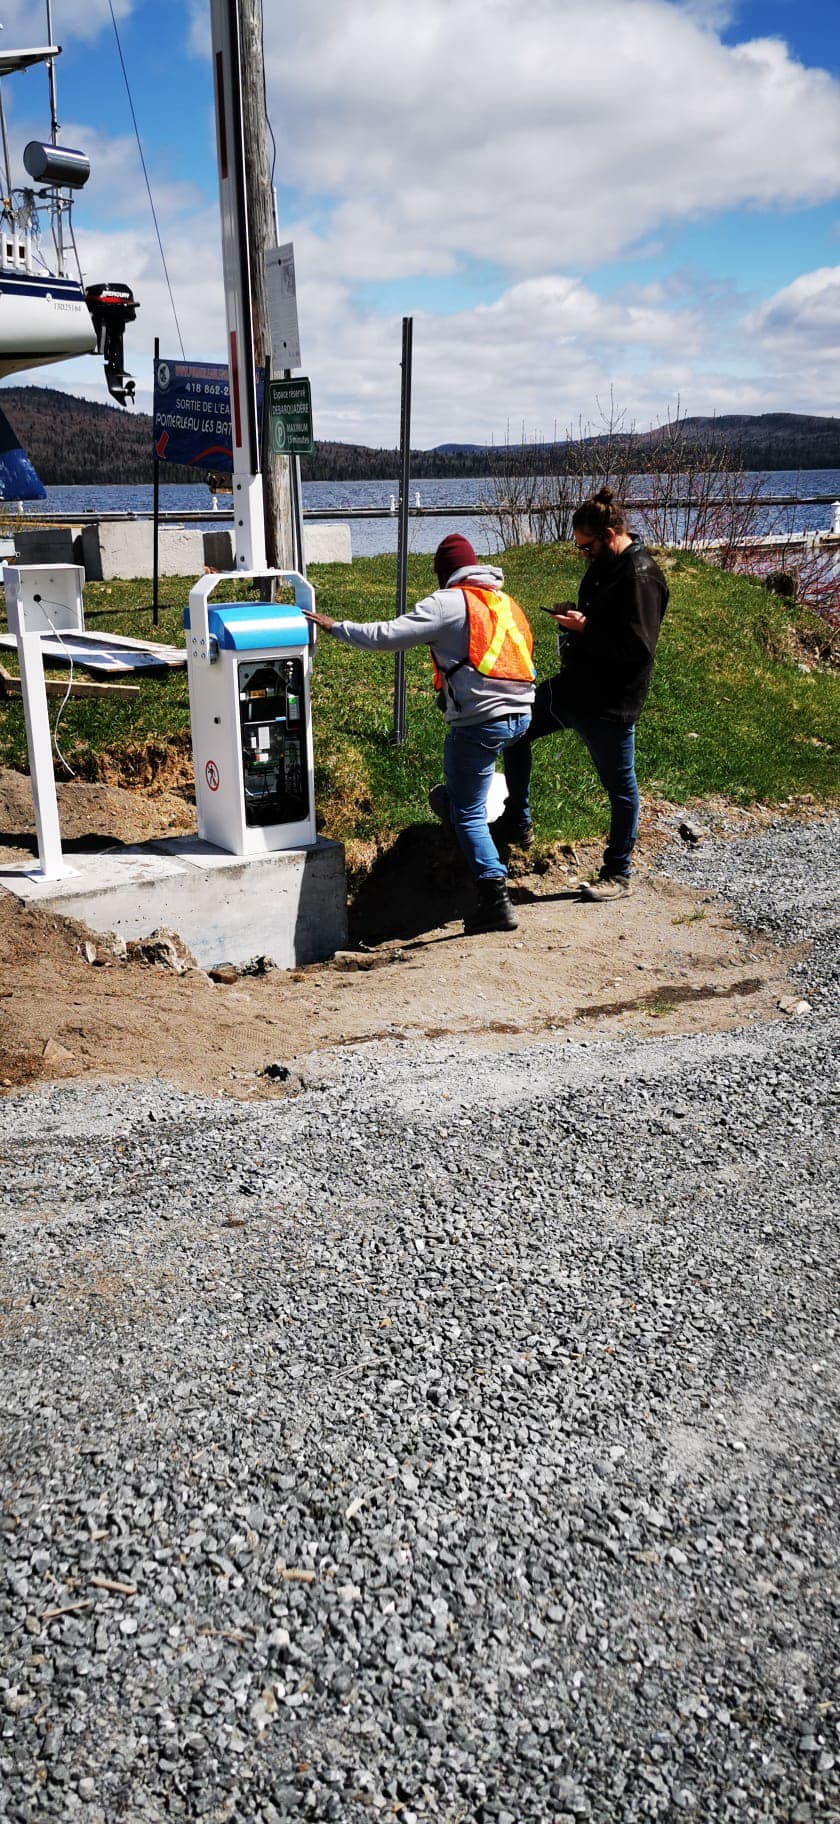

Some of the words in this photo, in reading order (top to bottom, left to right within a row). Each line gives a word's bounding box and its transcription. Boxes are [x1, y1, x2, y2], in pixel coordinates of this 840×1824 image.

[185, 382, 201, 393] 418
[204, 383, 230, 396] 862-2
[273, 389, 288, 400] Espace
[175, 398, 201, 411] SORTIE
[202, 401, 212, 413] DE
[214, 403, 231, 415] L'EA
[155, 413, 200, 432] POMERLEAU
[201, 419, 214, 433] LES
[216, 420, 232, 436] BAT
[286, 423, 308, 433] MAXIMUM
